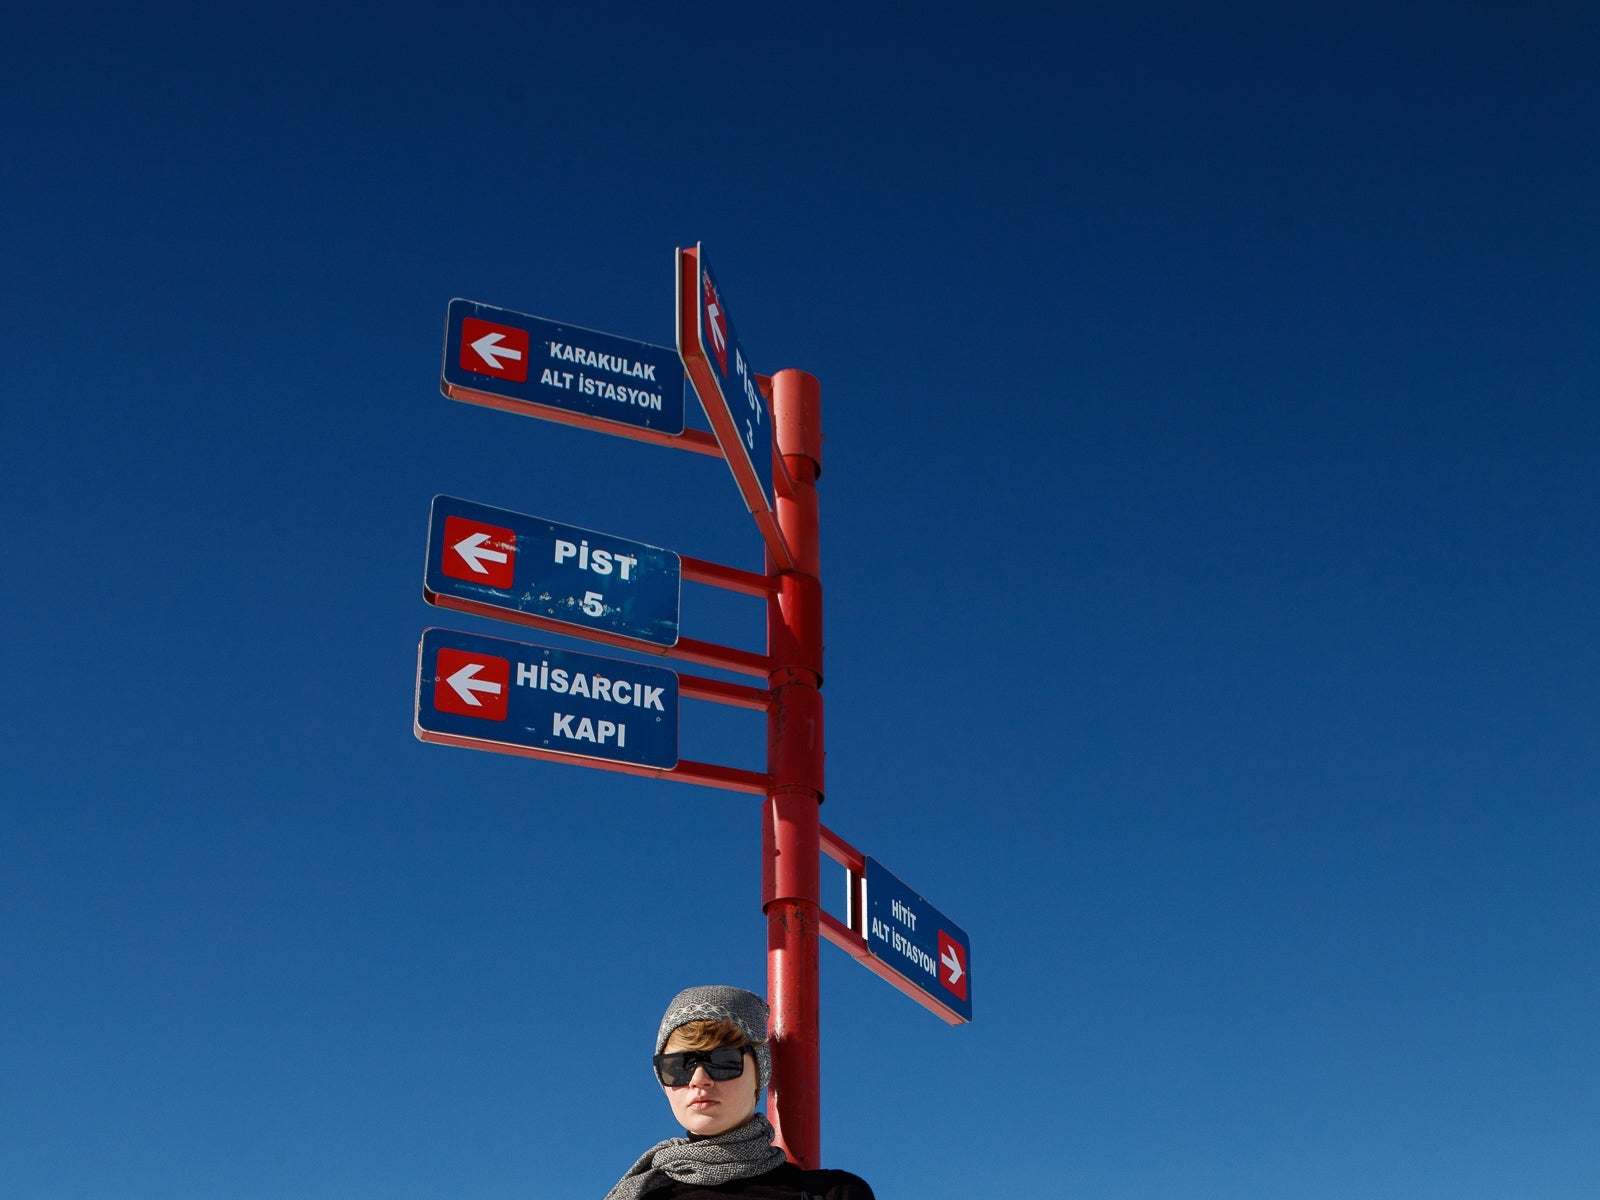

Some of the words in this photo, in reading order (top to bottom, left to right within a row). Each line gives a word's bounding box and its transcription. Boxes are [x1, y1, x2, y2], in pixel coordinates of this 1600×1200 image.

[549, 340, 656, 382] KARAKULAK
[540, 368, 574, 390] ALT
[578, 372, 662, 411] İSTASYON
[735, 347, 762, 426] PİST
[746, 418, 754, 450] 3
[554, 538, 638, 581] PİST
[582, 590, 604, 617] 5
[516, 660, 665, 711] HİSARCIK
[552, 712, 626, 748] KAPI
[891, 898, 917, 932] HİTİT
[872, 916, 890, 943] ALT
[892, 925, 937, 978] İSTASYON
